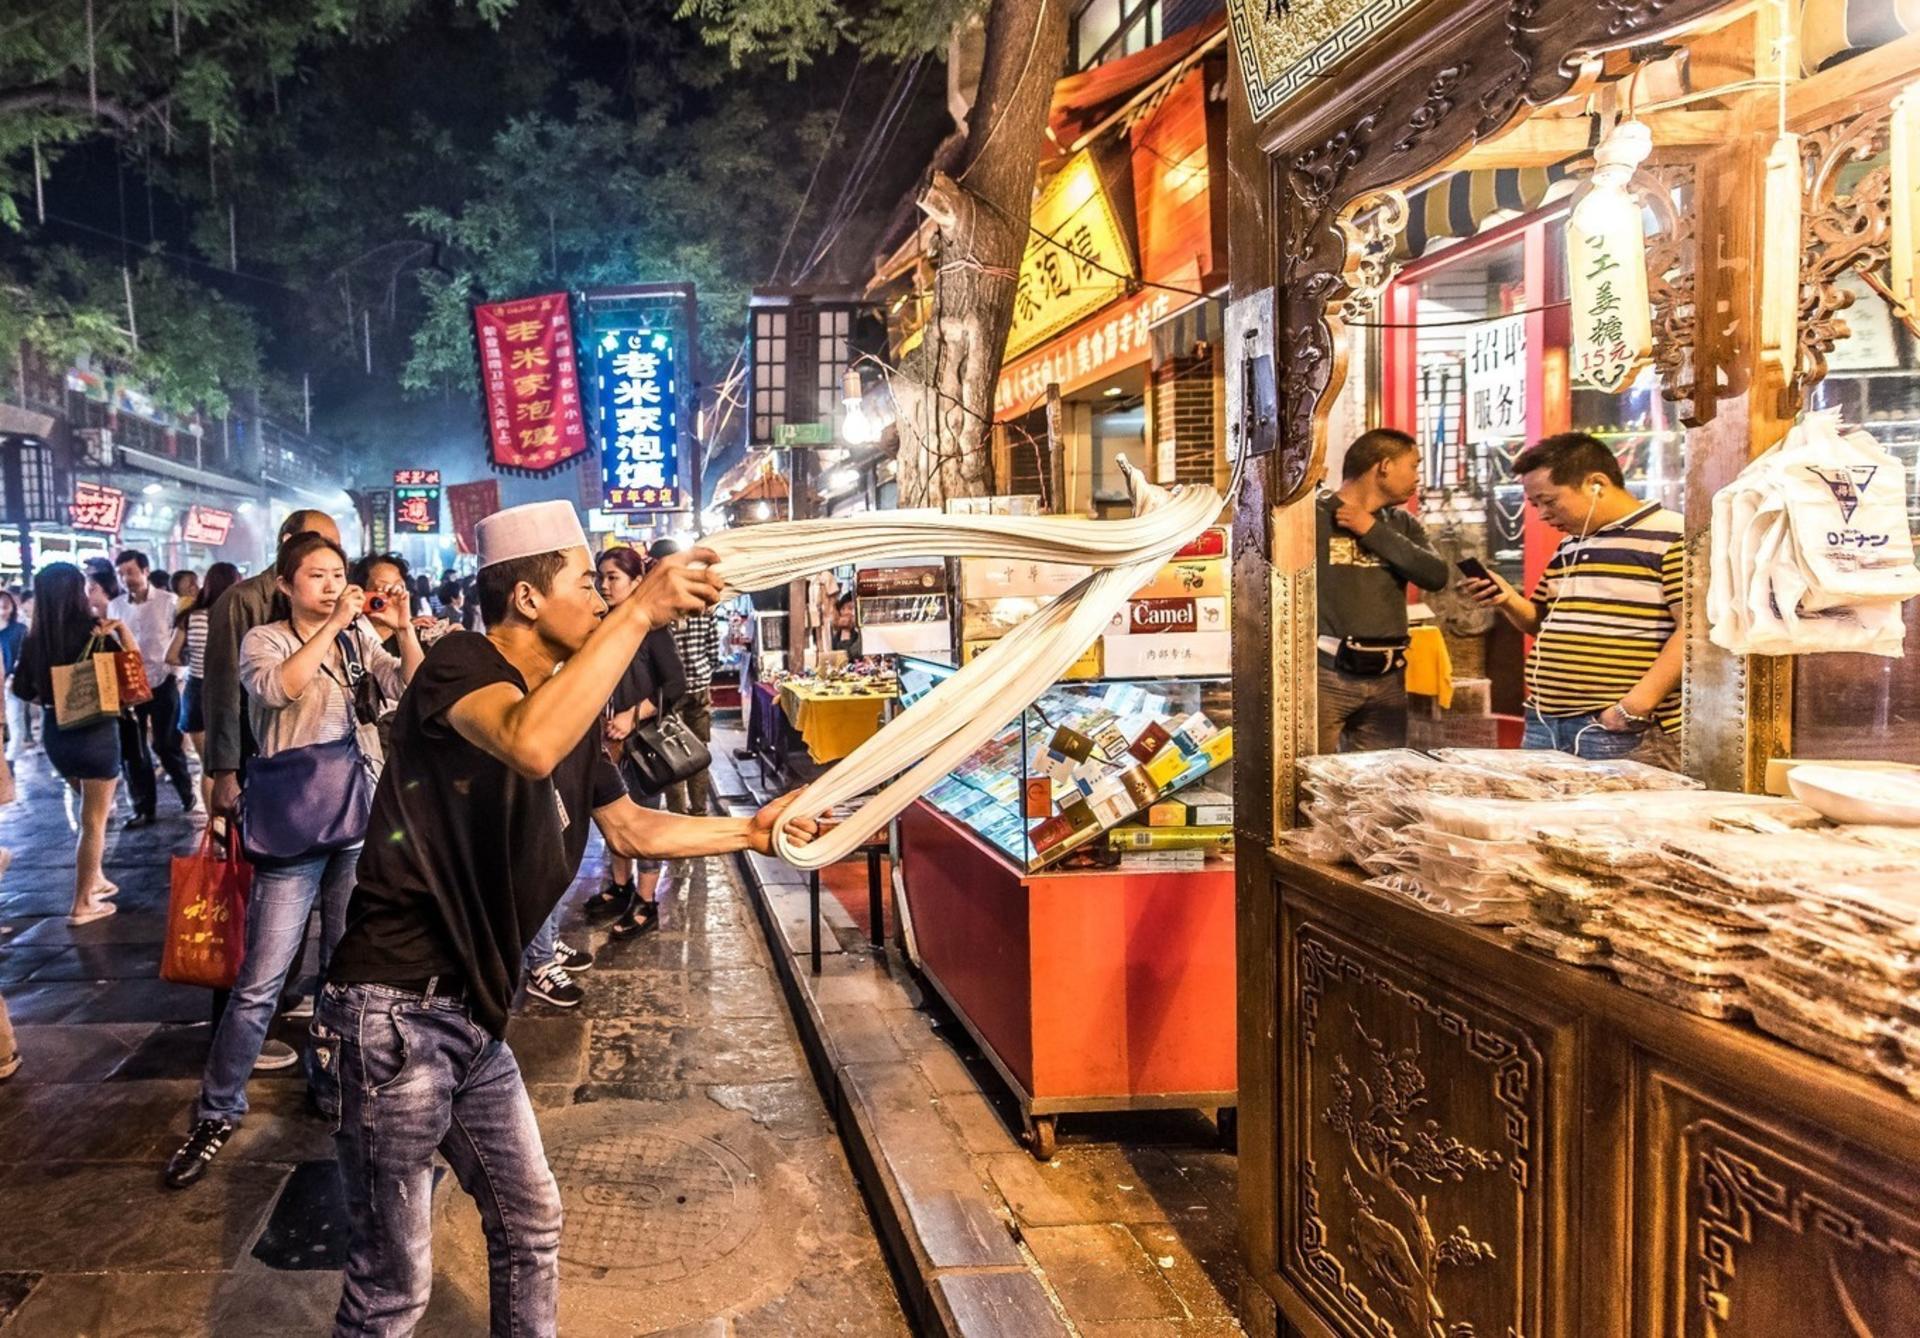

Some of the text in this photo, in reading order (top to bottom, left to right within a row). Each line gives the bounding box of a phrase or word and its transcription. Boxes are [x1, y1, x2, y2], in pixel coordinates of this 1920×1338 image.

[505, 320, 560, 449] 老米家泡馍
[612, 350, 665, 488] 老米家泡馍
[1133, 603, 1194, 625] Camel
